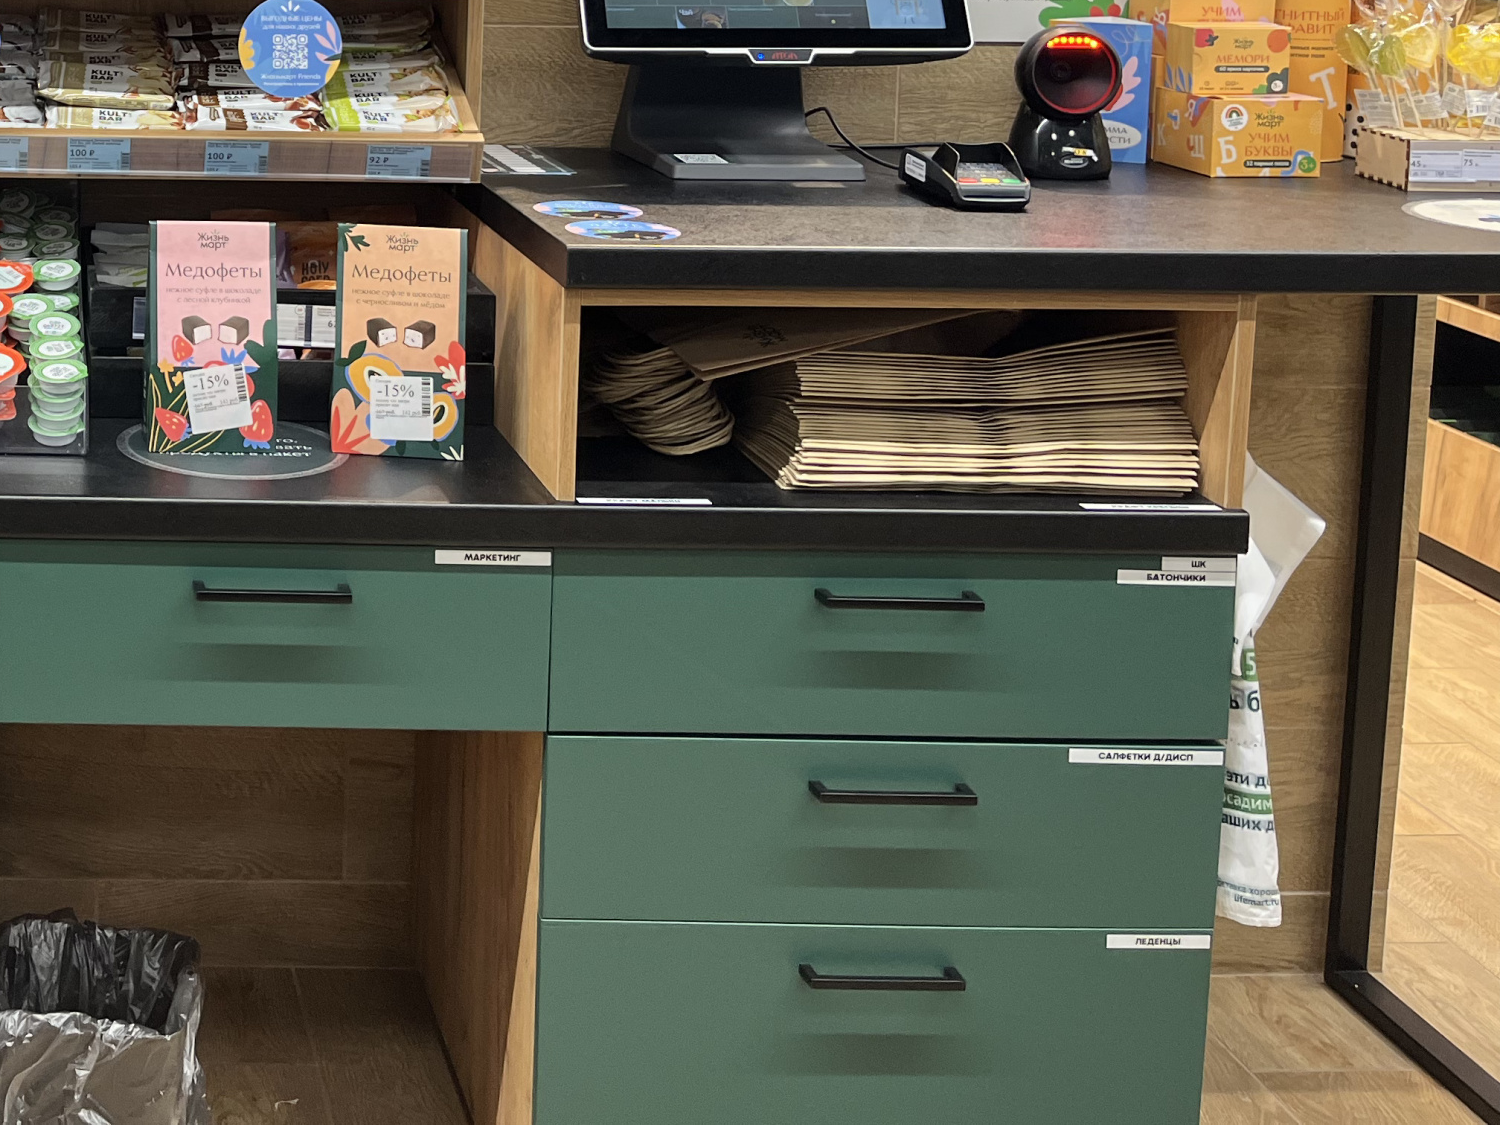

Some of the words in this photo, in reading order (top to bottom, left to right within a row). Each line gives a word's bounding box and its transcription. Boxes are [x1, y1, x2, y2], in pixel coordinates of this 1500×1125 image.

[1202, 7, 1242, 17] УЧИМ
[1216, 55, 1270, 63] МЕМОРИ
[91, 69, 118, 77] KULT
[1248, 133, 1290, 144] УЧИМ
[70, 149, 86, 157] 100
[1244, 146, 1293, 157] БУКВЫ
[207, 153, 224, 161] 100
[368, 156, 380, 164] 92
[197, 232, 230, 243] Жизнь
[386, 233, 419, 245] Жизнь
[200, 241, 228, 251] март
[388, 243, 417, 253] март
[165, 263, 262, 283] Медофеты
[352, 264, 452, 285] Медофеты
[166, 287, 194, 295] нежное
[195, 287, 216, 296] суфле
[224, 287, 262, 295] шоколаде
[352, 289, 379, 297] нежное
[381, 290, 404, 299] суфле
[412, 291, 450, 300] шоколаде
[184, 295, 209, 304] лесной
[210, 295, 250, 305] клубникой
[363, 297, 412, 306] черносливом
[193, 373, 230, 391] -15%
[377, 383, 415, 401] -15%
[464, 553, 522, 561] МАРКЕТИНГ
[1190, 560, 1207, 569] ШК
[1146, 573, 1206, 583] БАТОНЧИКИ
[1098, 751, 1152, 761] САЛФЕТКИ
[1153, 753, 1194, 763] Д/ДИСП
[1226, 771, 1250, 787] эти
[1135, 937, 1181, 947] ЛЕДЕНЦЫ
